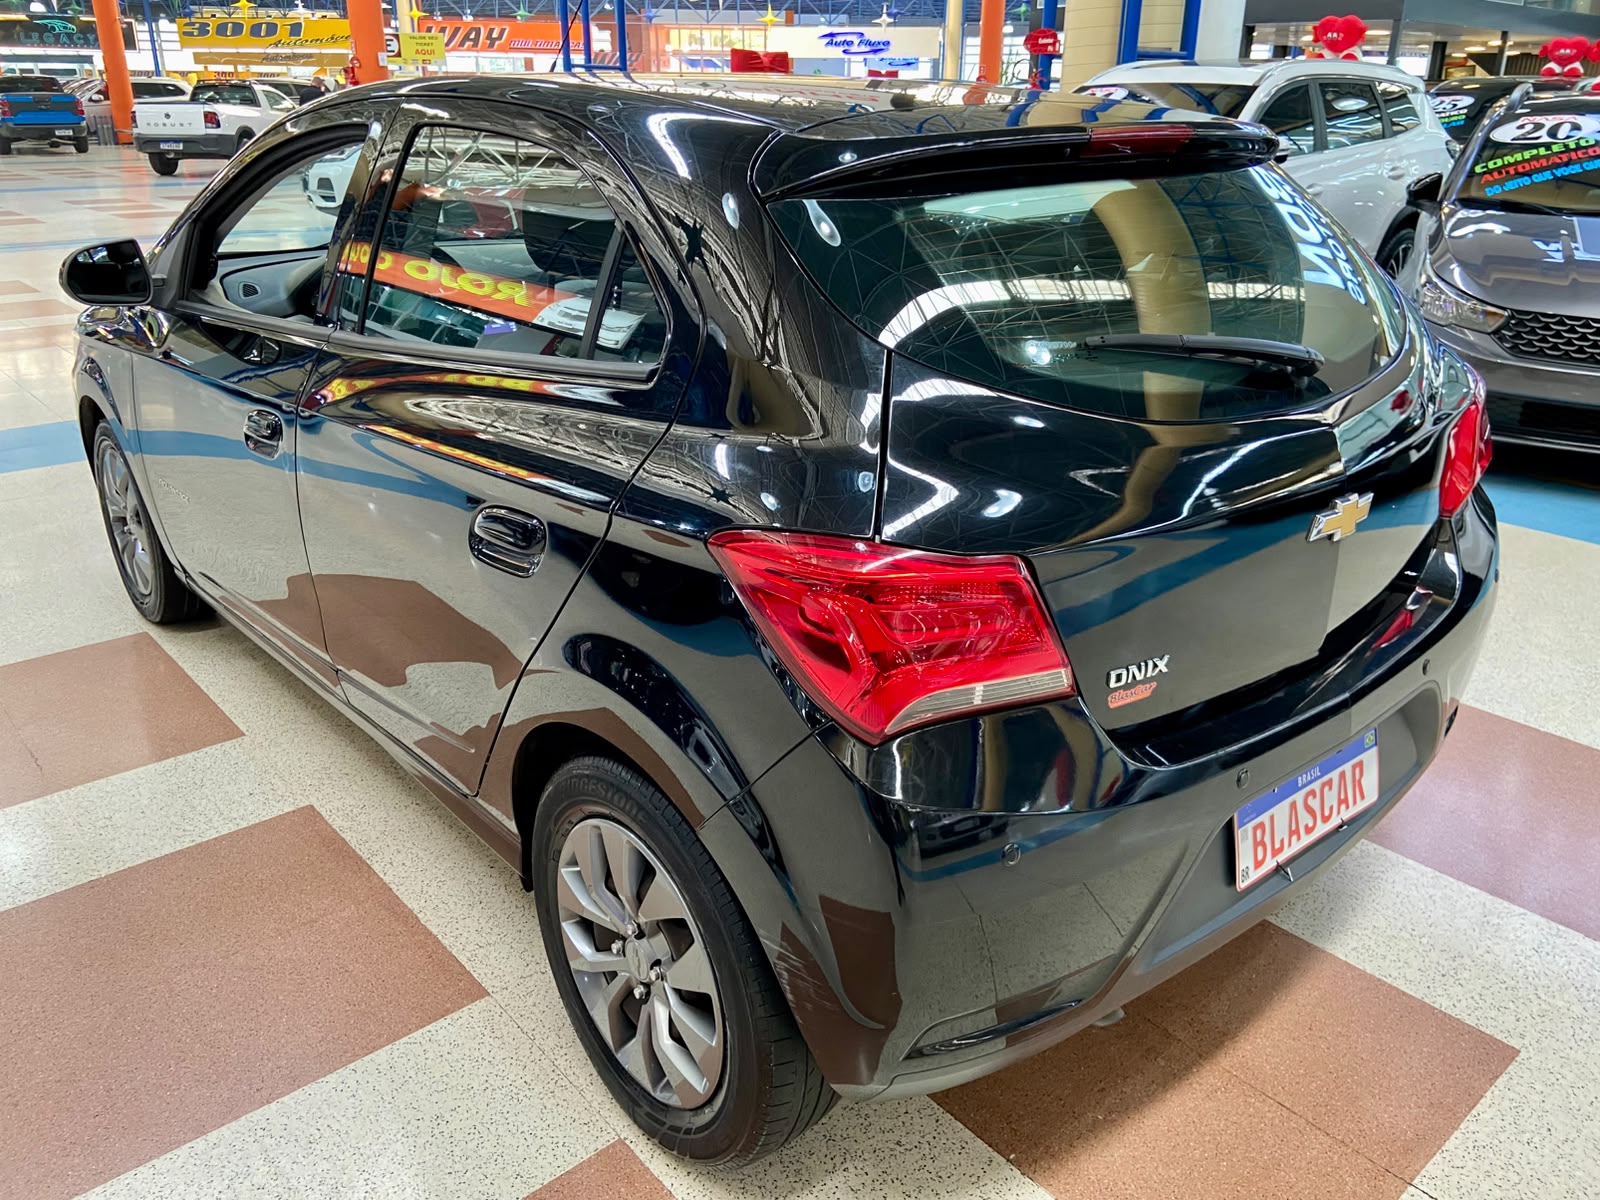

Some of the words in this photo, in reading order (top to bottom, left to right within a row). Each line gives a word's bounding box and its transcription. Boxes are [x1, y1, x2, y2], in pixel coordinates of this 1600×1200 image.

[20, 31, 97, 44] LEGACY
[181, 20, 304, 38] 3001
[265, 34, 351, 48] Automóve
[509, 40, 584, 49] MULTIMACA
[825, 38, 854, 47] Auto
[857, 38, 891, 47] Fluxo
[1510, 121, 1583, 141] 20
[1474, 137, 1596, 173] COMPLETO
[1481, 146, 1600, 184] AUTOMATICO
[1485, 184, 1502, 197] DO
[1531, 169, 1554, 183] QUE
[1553, 162, 1583, 177] VOCE
[1106, 654, 1170, 689] ONIX
[1297, 766, 1321, 787] BRASIL
[1252, 759, 1366, 872] BLASCAR
[1240, 865, 1250, 884] BR
